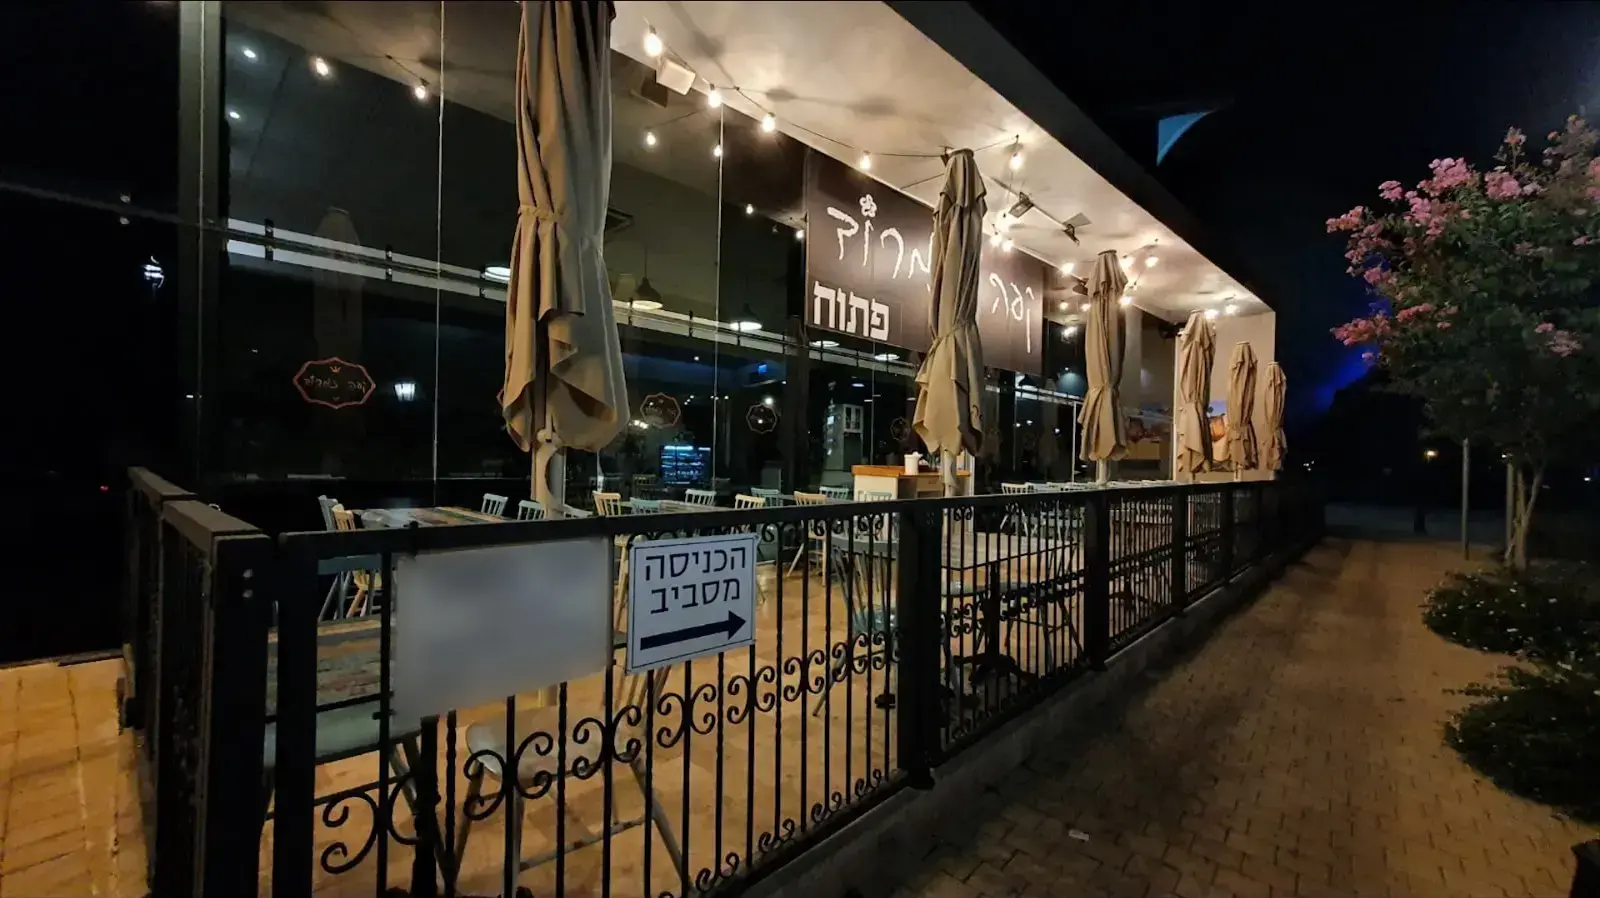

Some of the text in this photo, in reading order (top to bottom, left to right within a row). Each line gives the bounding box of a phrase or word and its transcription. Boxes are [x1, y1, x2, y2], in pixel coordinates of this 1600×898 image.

[827, 205, 1035, 353] קפה מרוד
[813, 280, 890, 342] פתוח
[645, 546, 746, 581] הכניסה
[650, 578, 740, 615] מסביב
